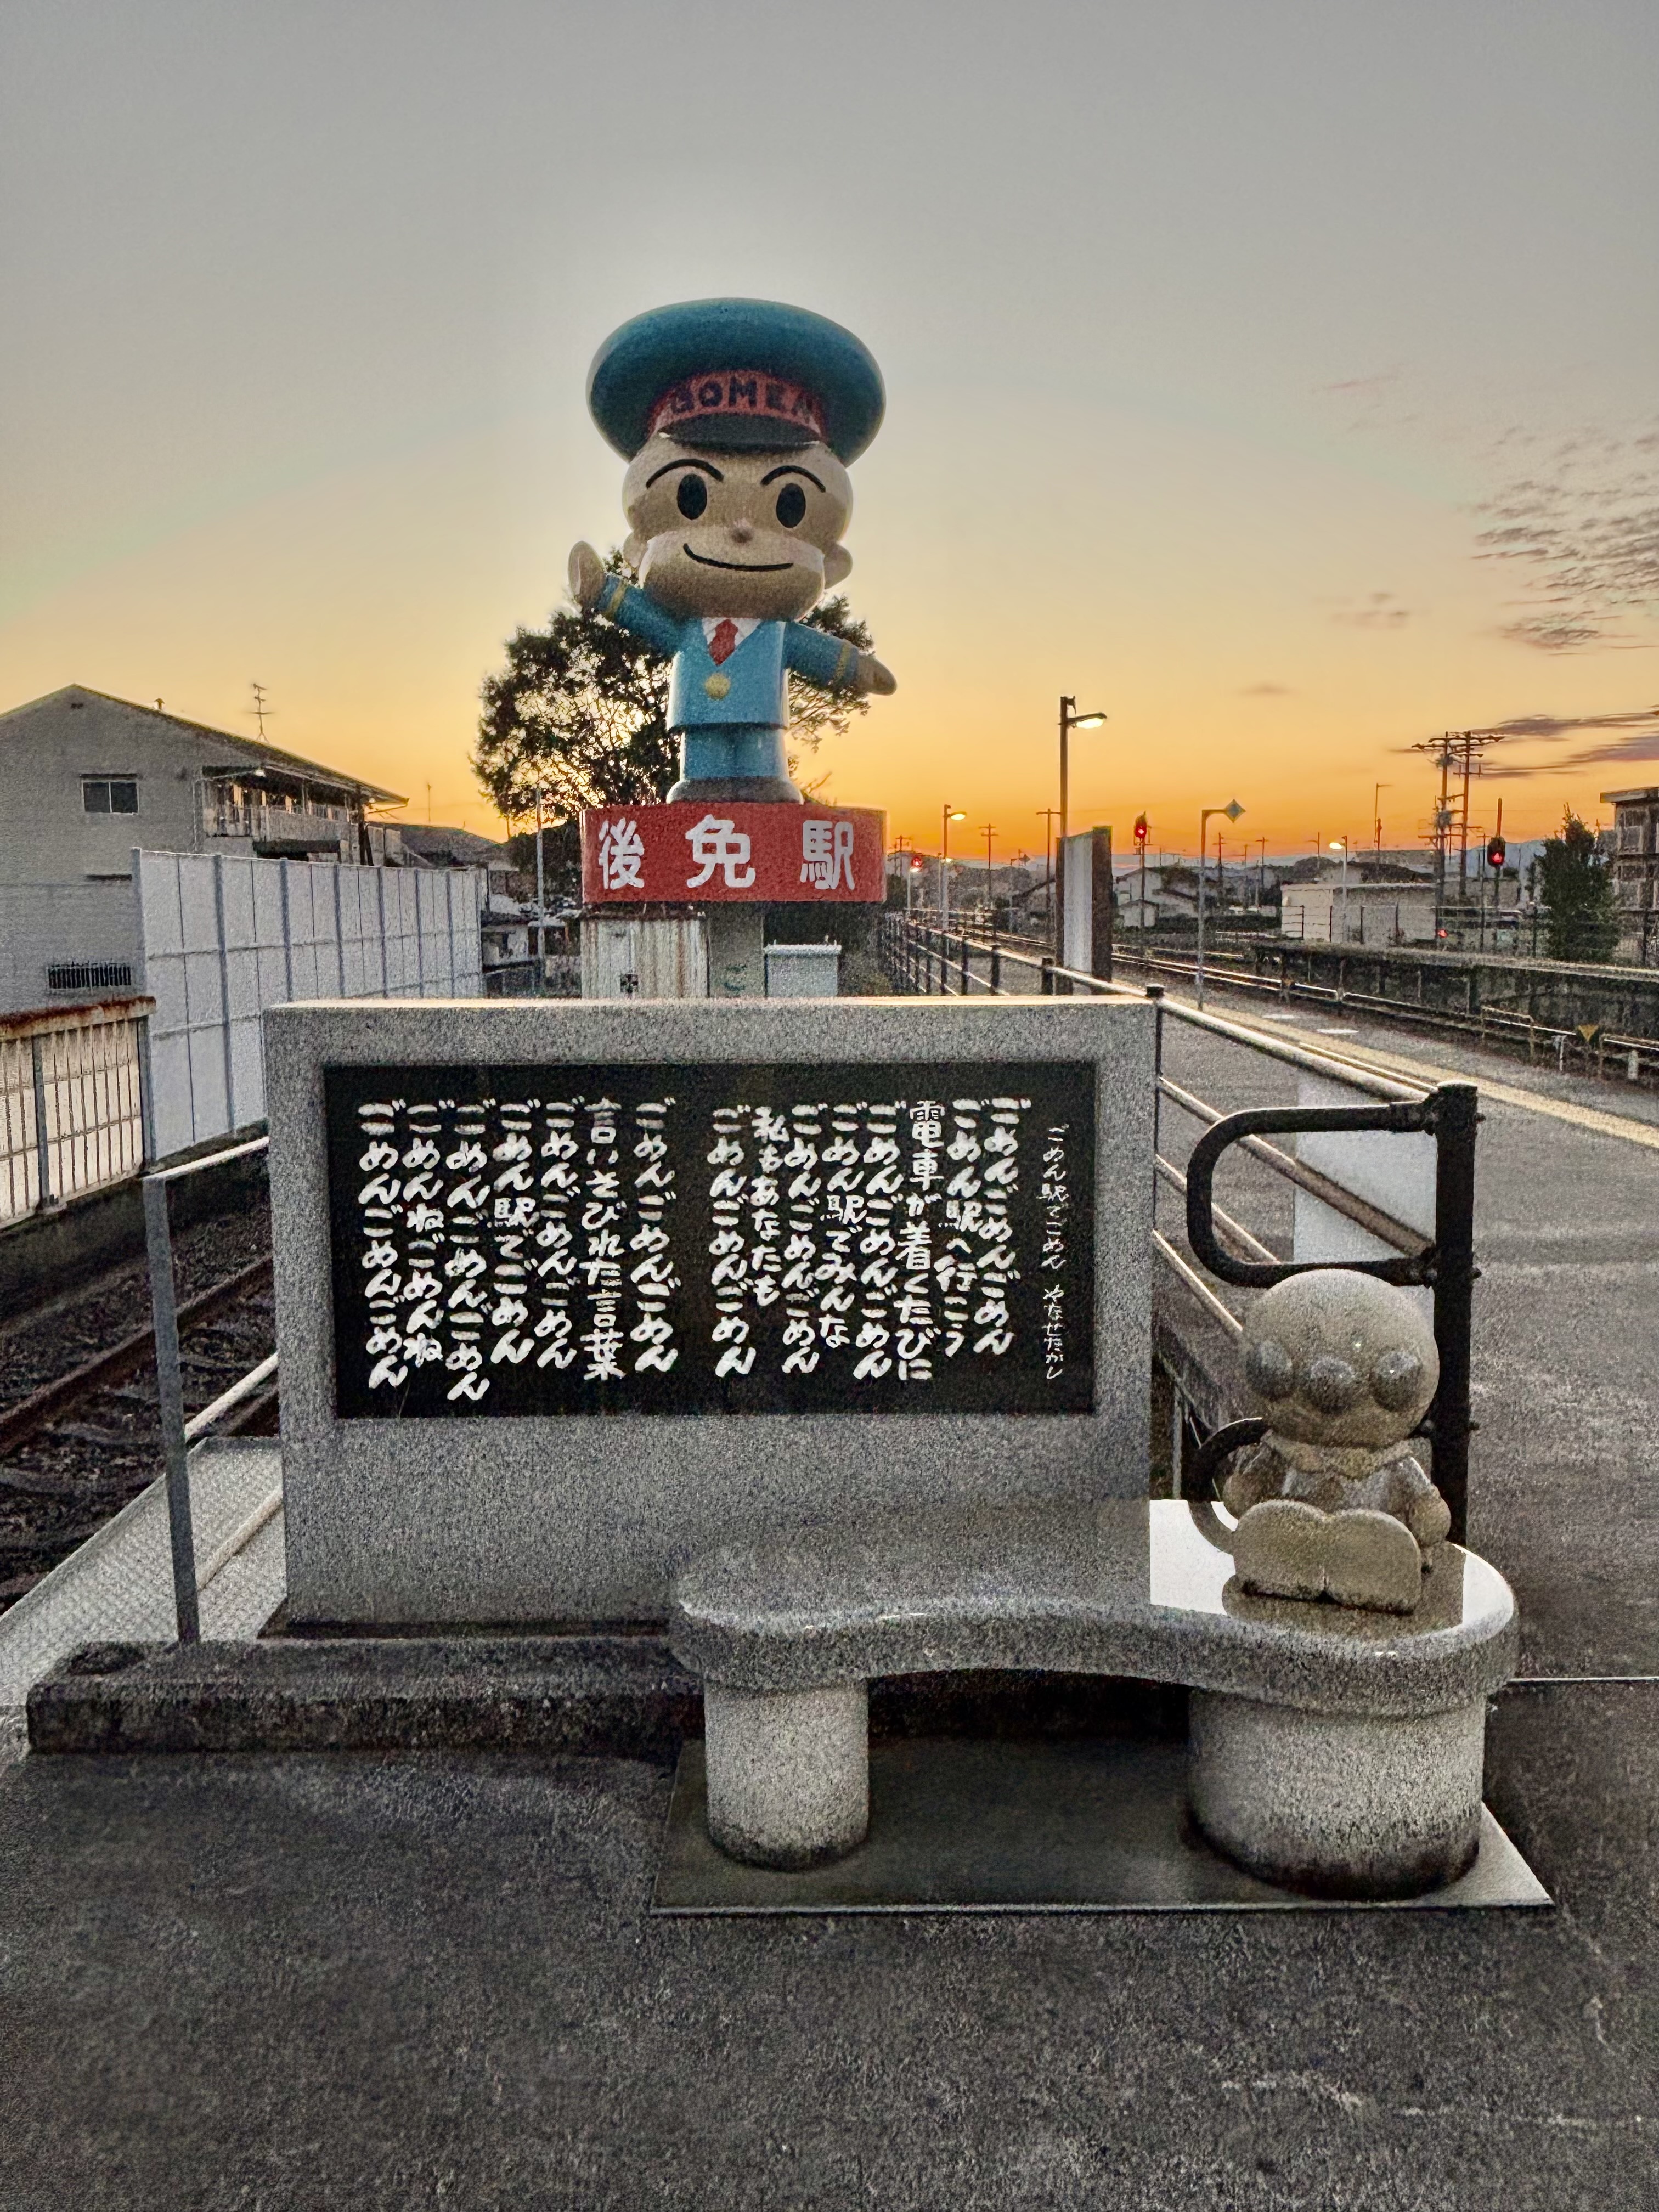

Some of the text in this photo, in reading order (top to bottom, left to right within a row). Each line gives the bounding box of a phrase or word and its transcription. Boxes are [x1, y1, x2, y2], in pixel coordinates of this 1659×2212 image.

[598, 814, 855, 890] 後免駅
[358, 1098, 408, 1389] ごめんごめんごめん
[402, 1099, 455, 1368] ごめんねごめんね
[445, 1098, 496, 1401] ごめんごめんごめん
[487, 1098, 541, 1364] ごめん駅でごめん
[534, 1096, 585, 1369] ごめんごめんごめん
[579, 1096, 627, 1381] 言いそびれた言葉
[630, 1096, 681, 1372] ごめんごめんごめん
[707, 1104, 757, 1378] ごめんごめんごめん
[751, 1105, 790, 1306] 私もあなたも
[781, 1103, 828, 1374] ごめんごめんごめん
[815, 1101, 868, 1349] ごめん駅でみんな
[853, 1100, 907, 1380] ごめんごめんごめん
[893, 1100, 945, 1381] 電車が着くたびに
[933, 1098, 989, 1357] ごめん駅へ行こう
[973, 1097, 1031, 1355] ごめんごめんごめん
[1036, 1124, 1069, 1379] ごめん駅でごめん やなせたかし
